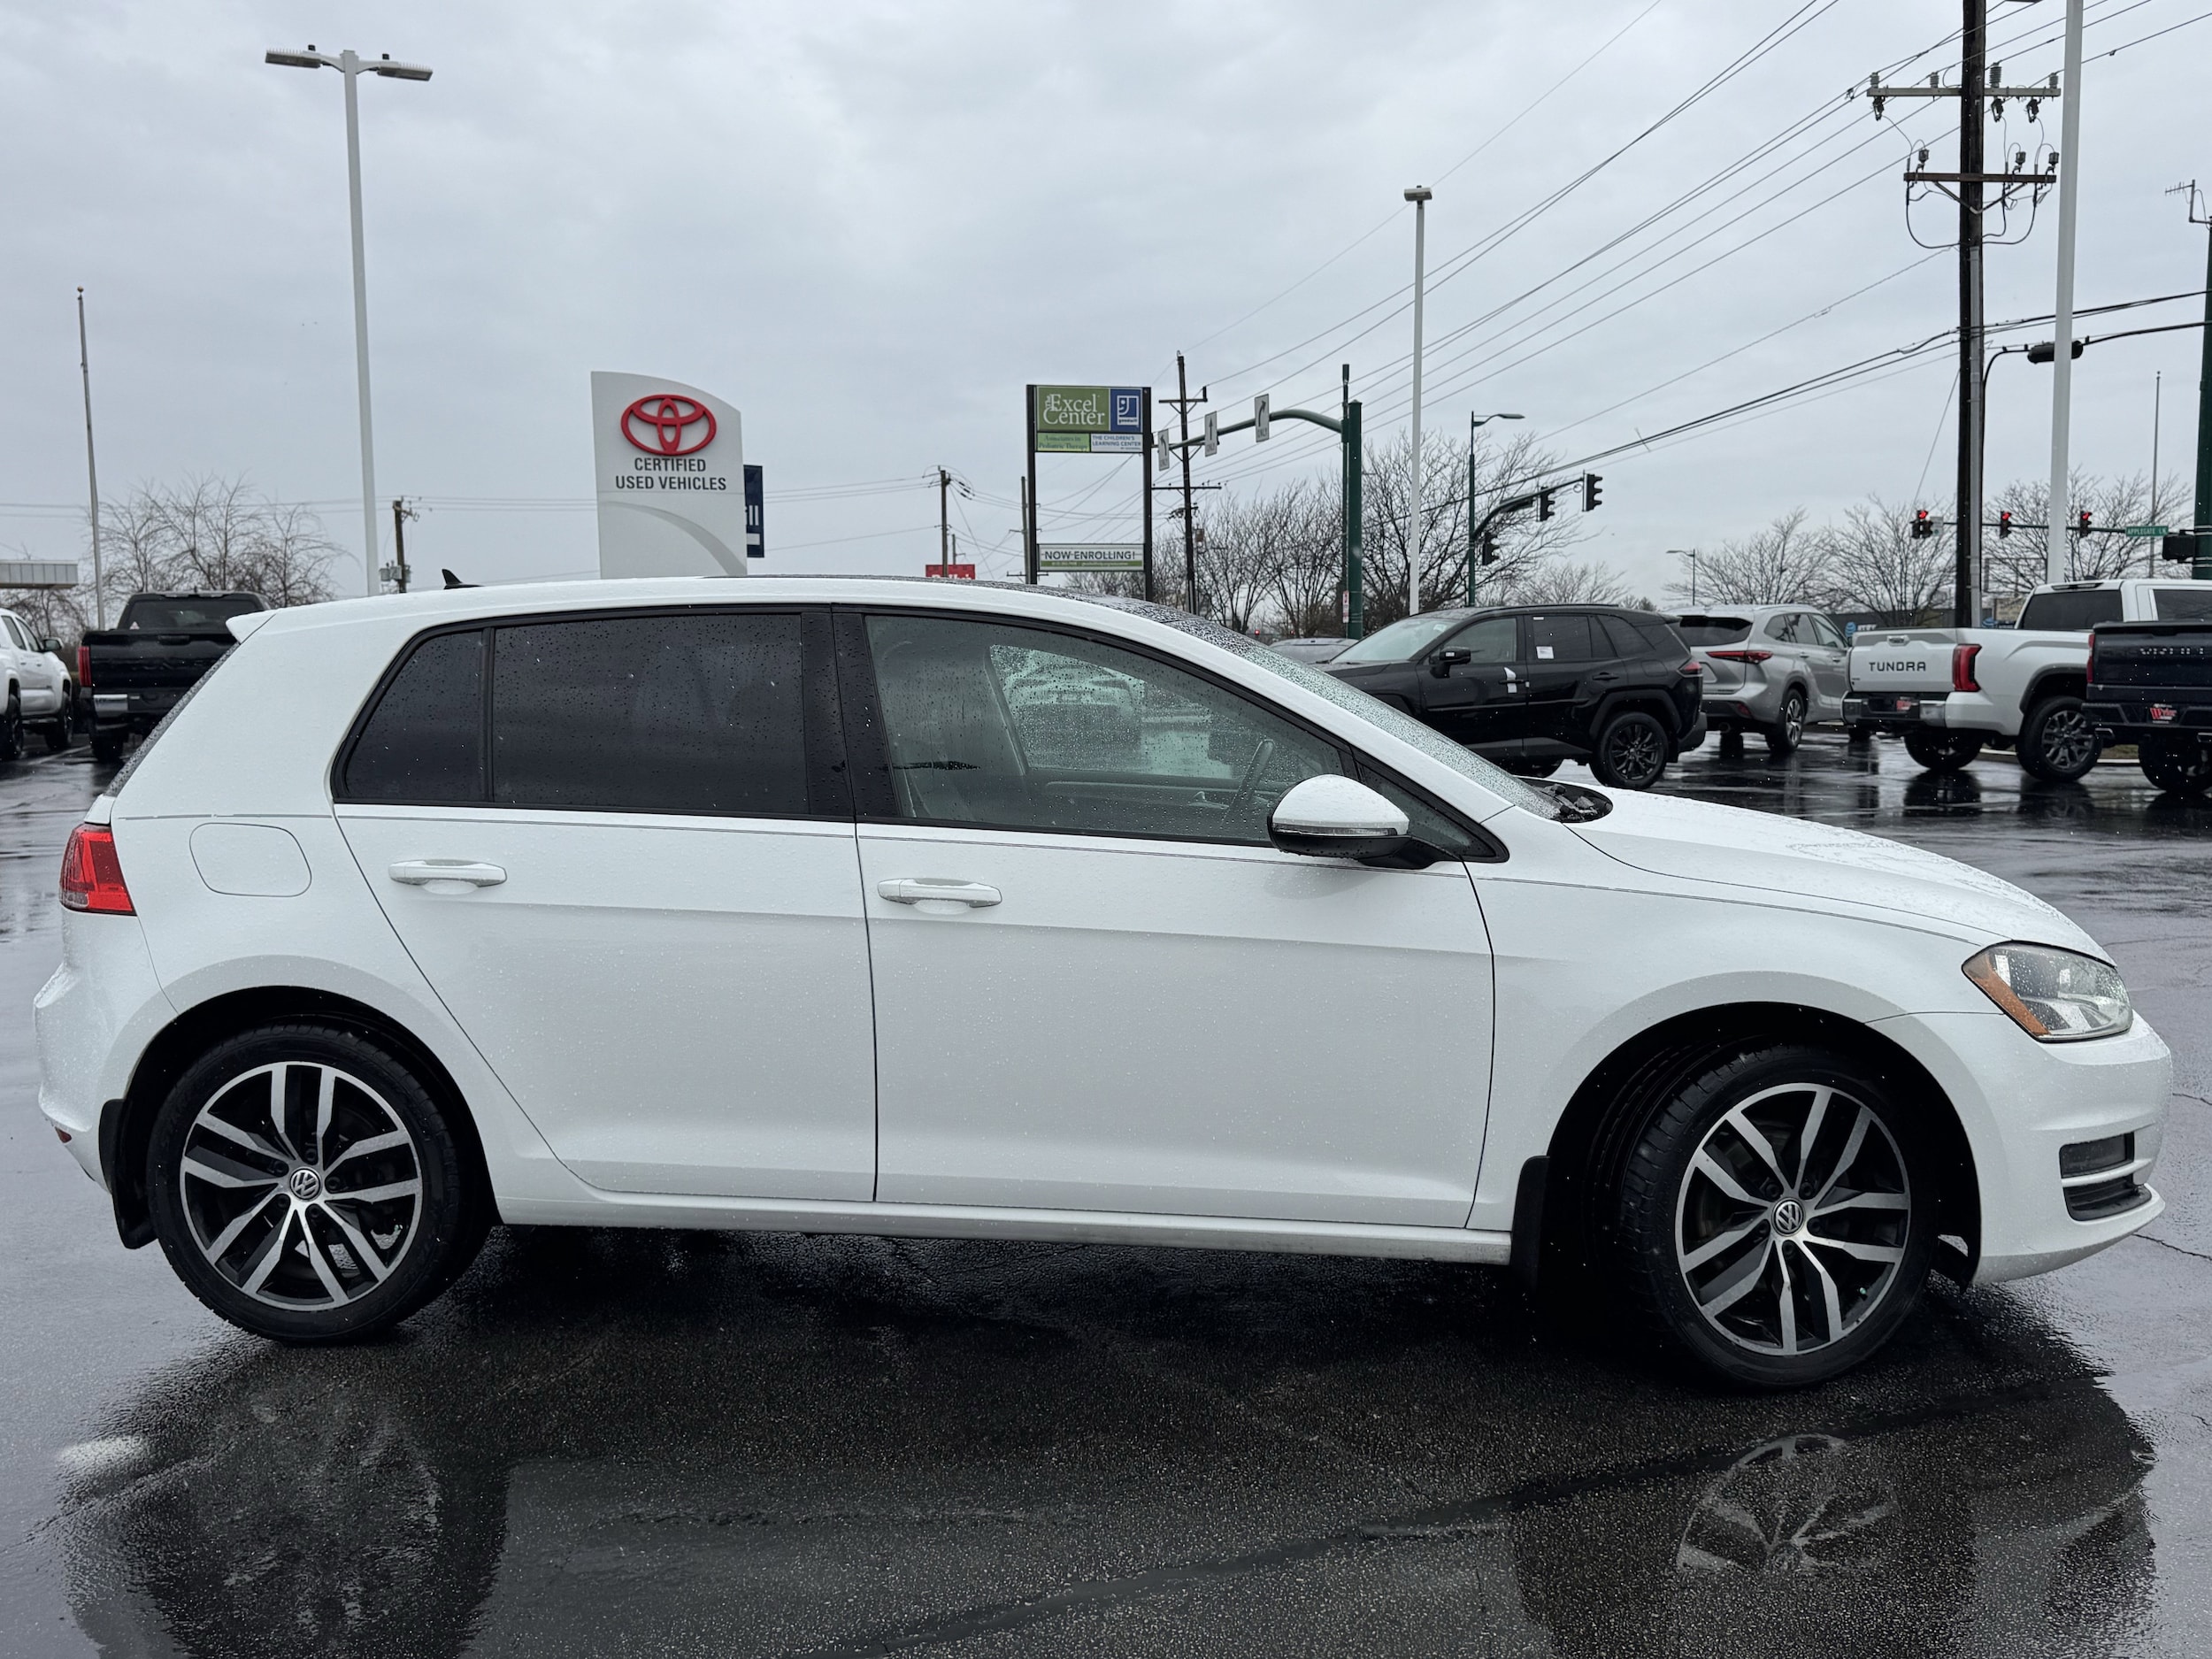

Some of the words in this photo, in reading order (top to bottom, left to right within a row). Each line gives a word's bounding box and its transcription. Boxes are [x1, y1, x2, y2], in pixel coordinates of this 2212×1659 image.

[1049, 394, 1098, 412] Excel
[1043, 407, 1105, 425] Center
[634, 457, 706, 472] CERTIFIED
[616, 475, 654, 489] USED
[659, 476, 726, 490] VEHICLES
[1044, 550, 1071, 560] NOW
[1073, 550, 1135, 560] ENROLLING!
[1869, 661, 1926, 672] TUNDRA
